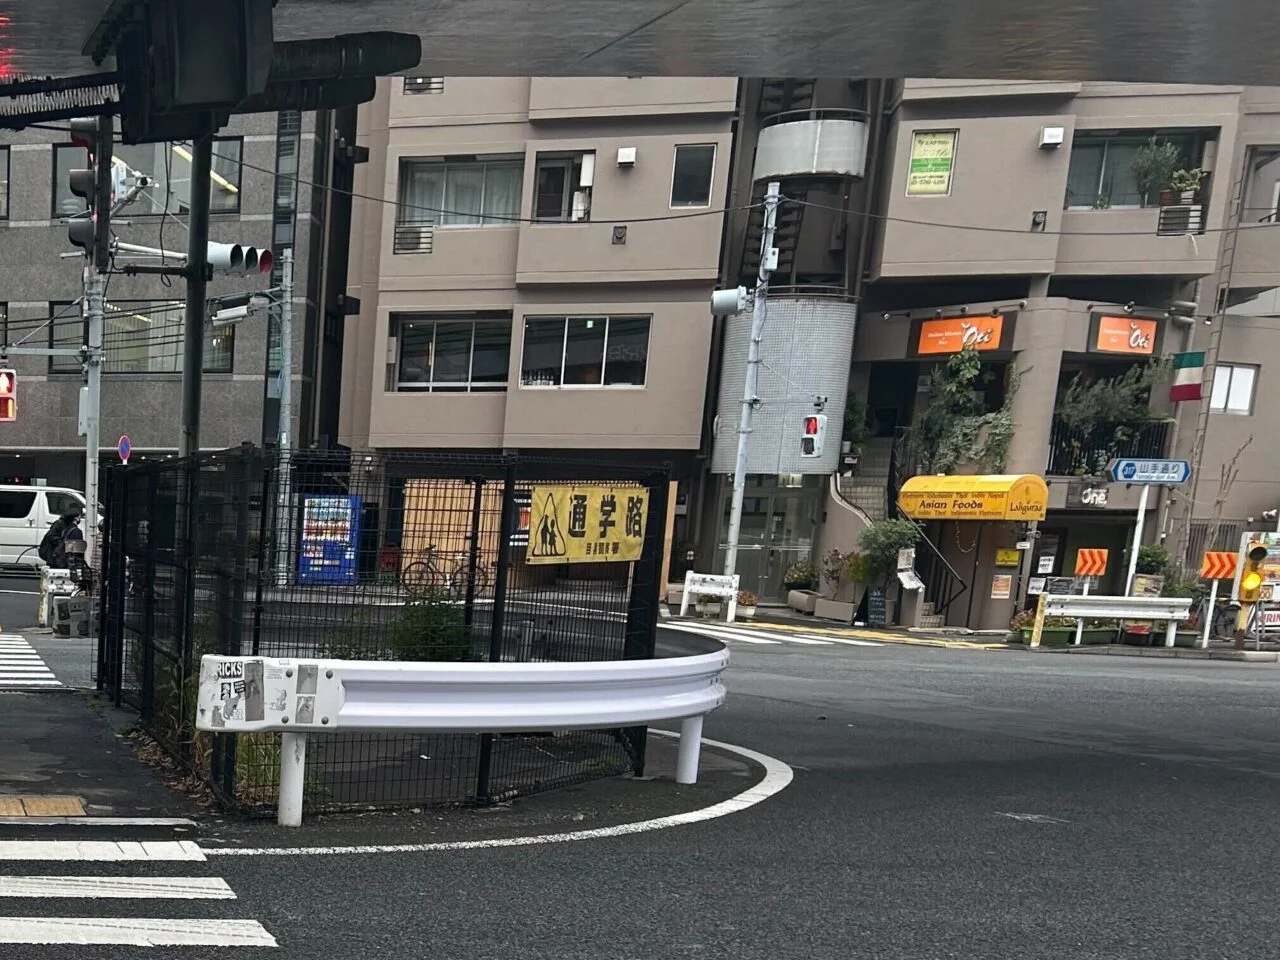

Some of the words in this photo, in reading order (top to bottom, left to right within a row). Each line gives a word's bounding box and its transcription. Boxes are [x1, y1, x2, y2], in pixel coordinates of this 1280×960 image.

[1123, 465, 1135, 475] 317
[1140, 462, 1180, 474] 山手通り
[920, 500, 947, 508] Asian
[953, 499, 983, 509] Foods
[568, 494, 643, 538] 通学路
